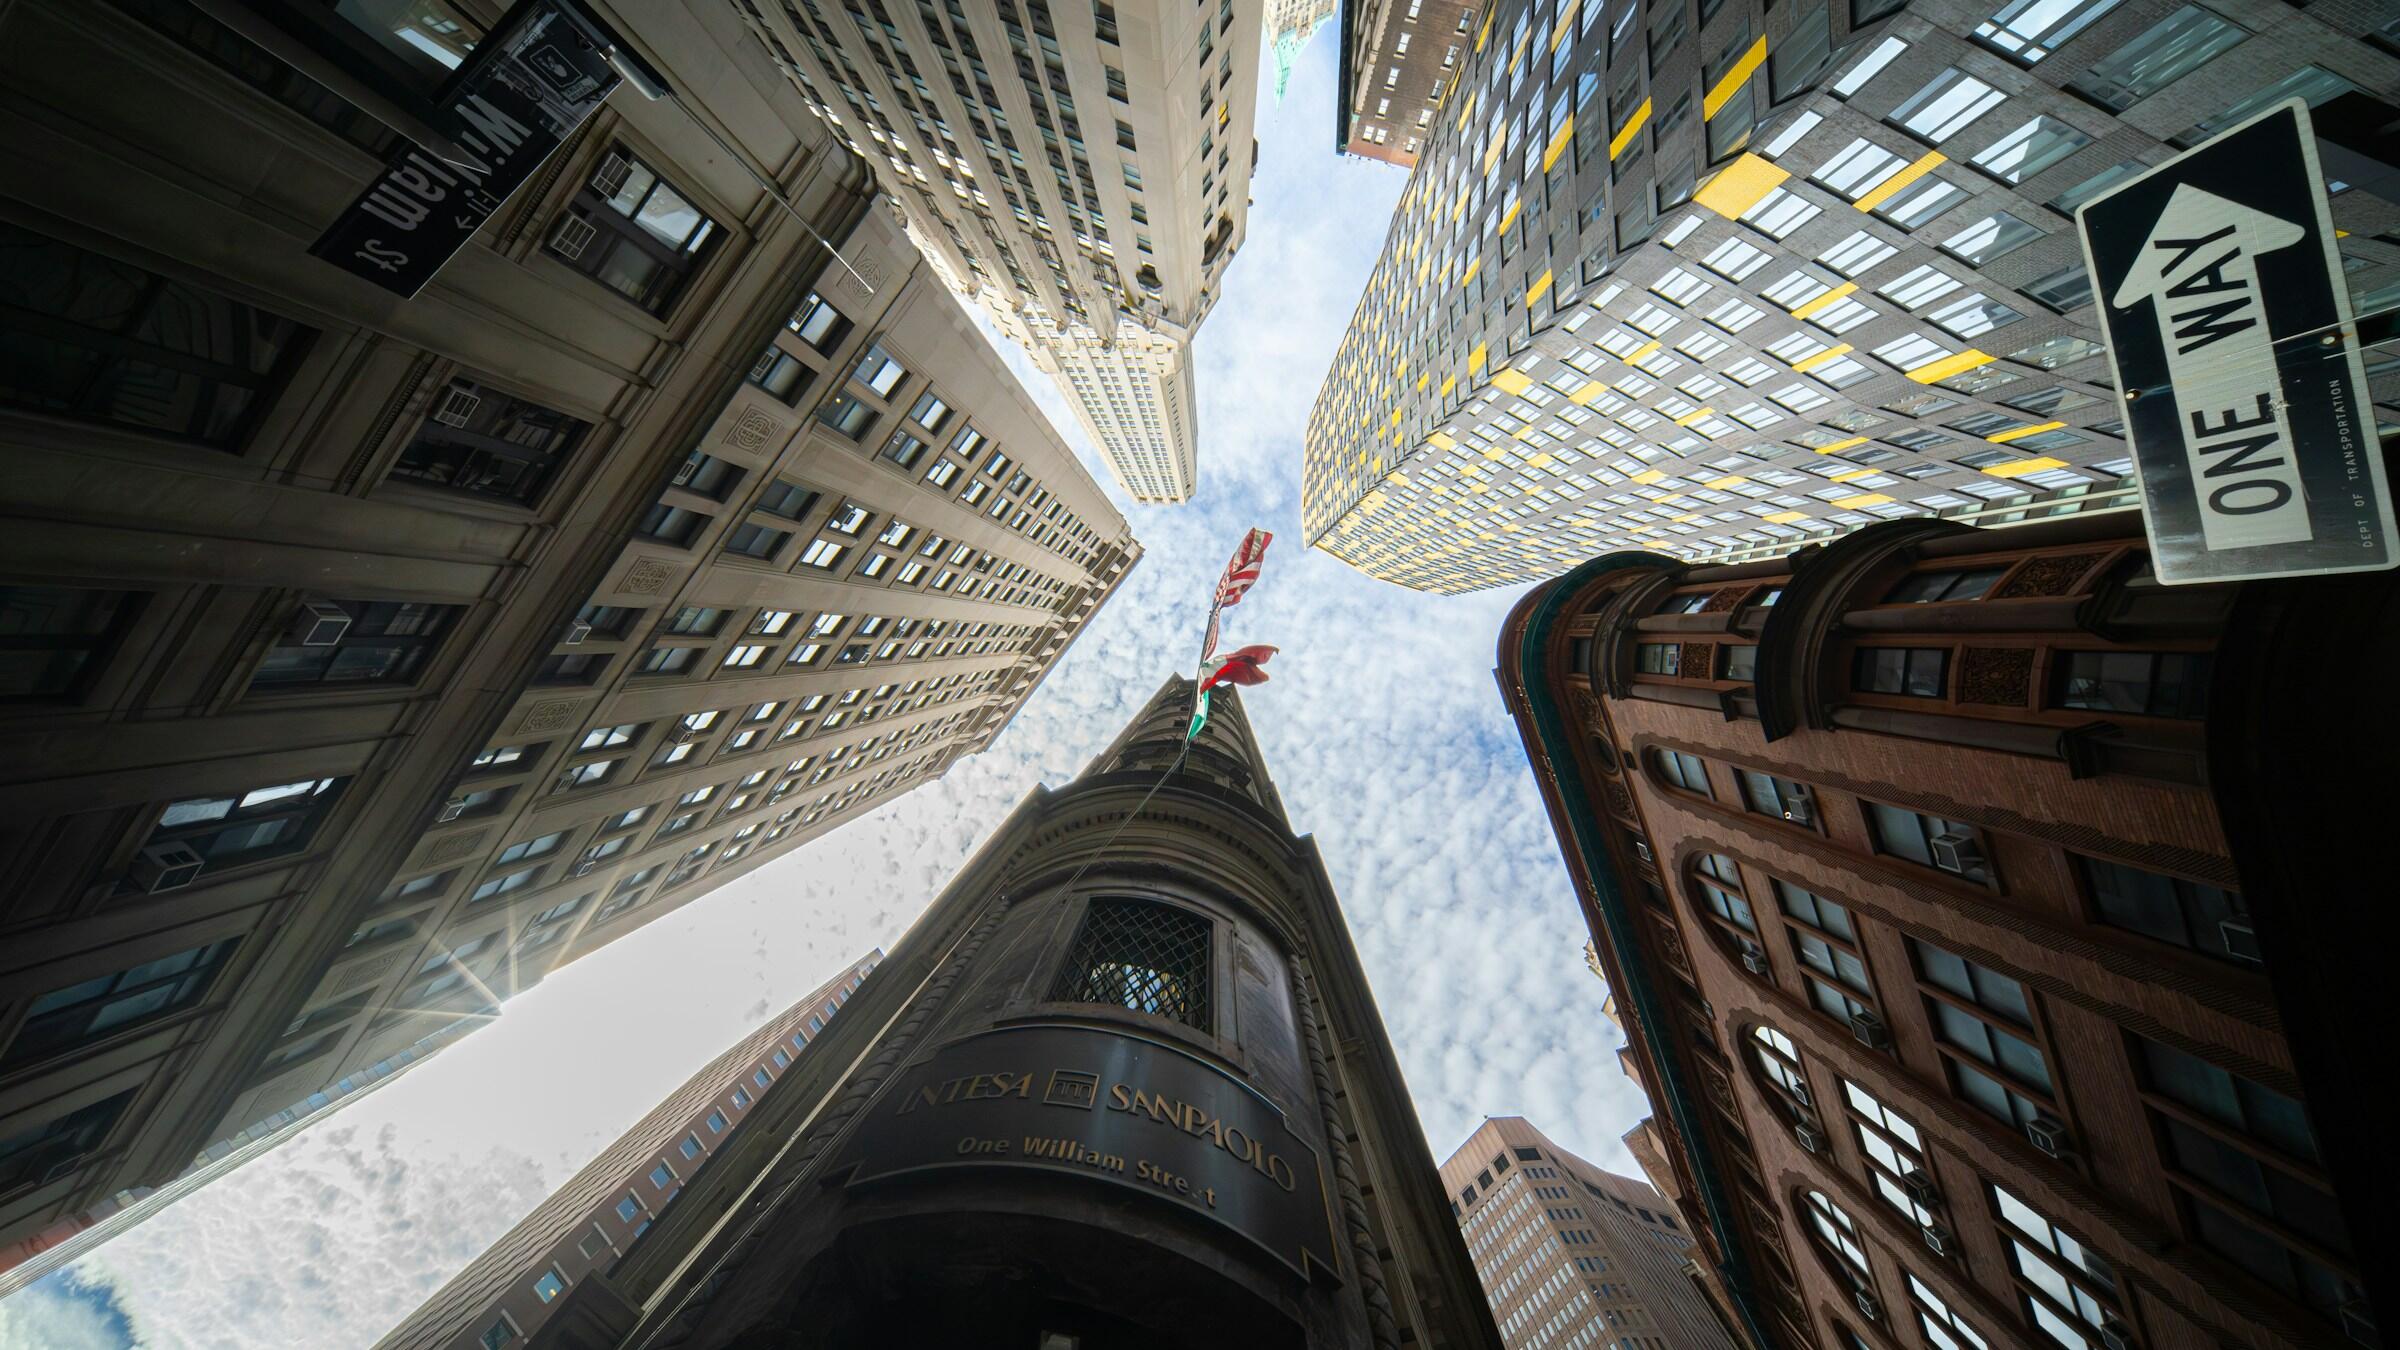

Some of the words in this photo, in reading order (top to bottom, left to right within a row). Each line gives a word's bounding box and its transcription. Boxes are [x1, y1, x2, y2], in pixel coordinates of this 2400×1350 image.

[354, 238, 409, 273] St
[2153, 223, 2257, 356] WAY
[2190, 392, 2293, 517] ONE
[2328, 378, 2359, 482] TRANSPORTATION
[2352, 493, 2366, 508] OF
[2357, 519, 2374, 549] DEPT
[895, 1071, 1034, 1116] INTESA
[1107, 1082, 1297, 1194] SANPAOLO
[956, 1136, 1010, 1156] One
[1023, 1136, 1125, 1175] William
[1136, 1159, 1217, 1209] Stret
